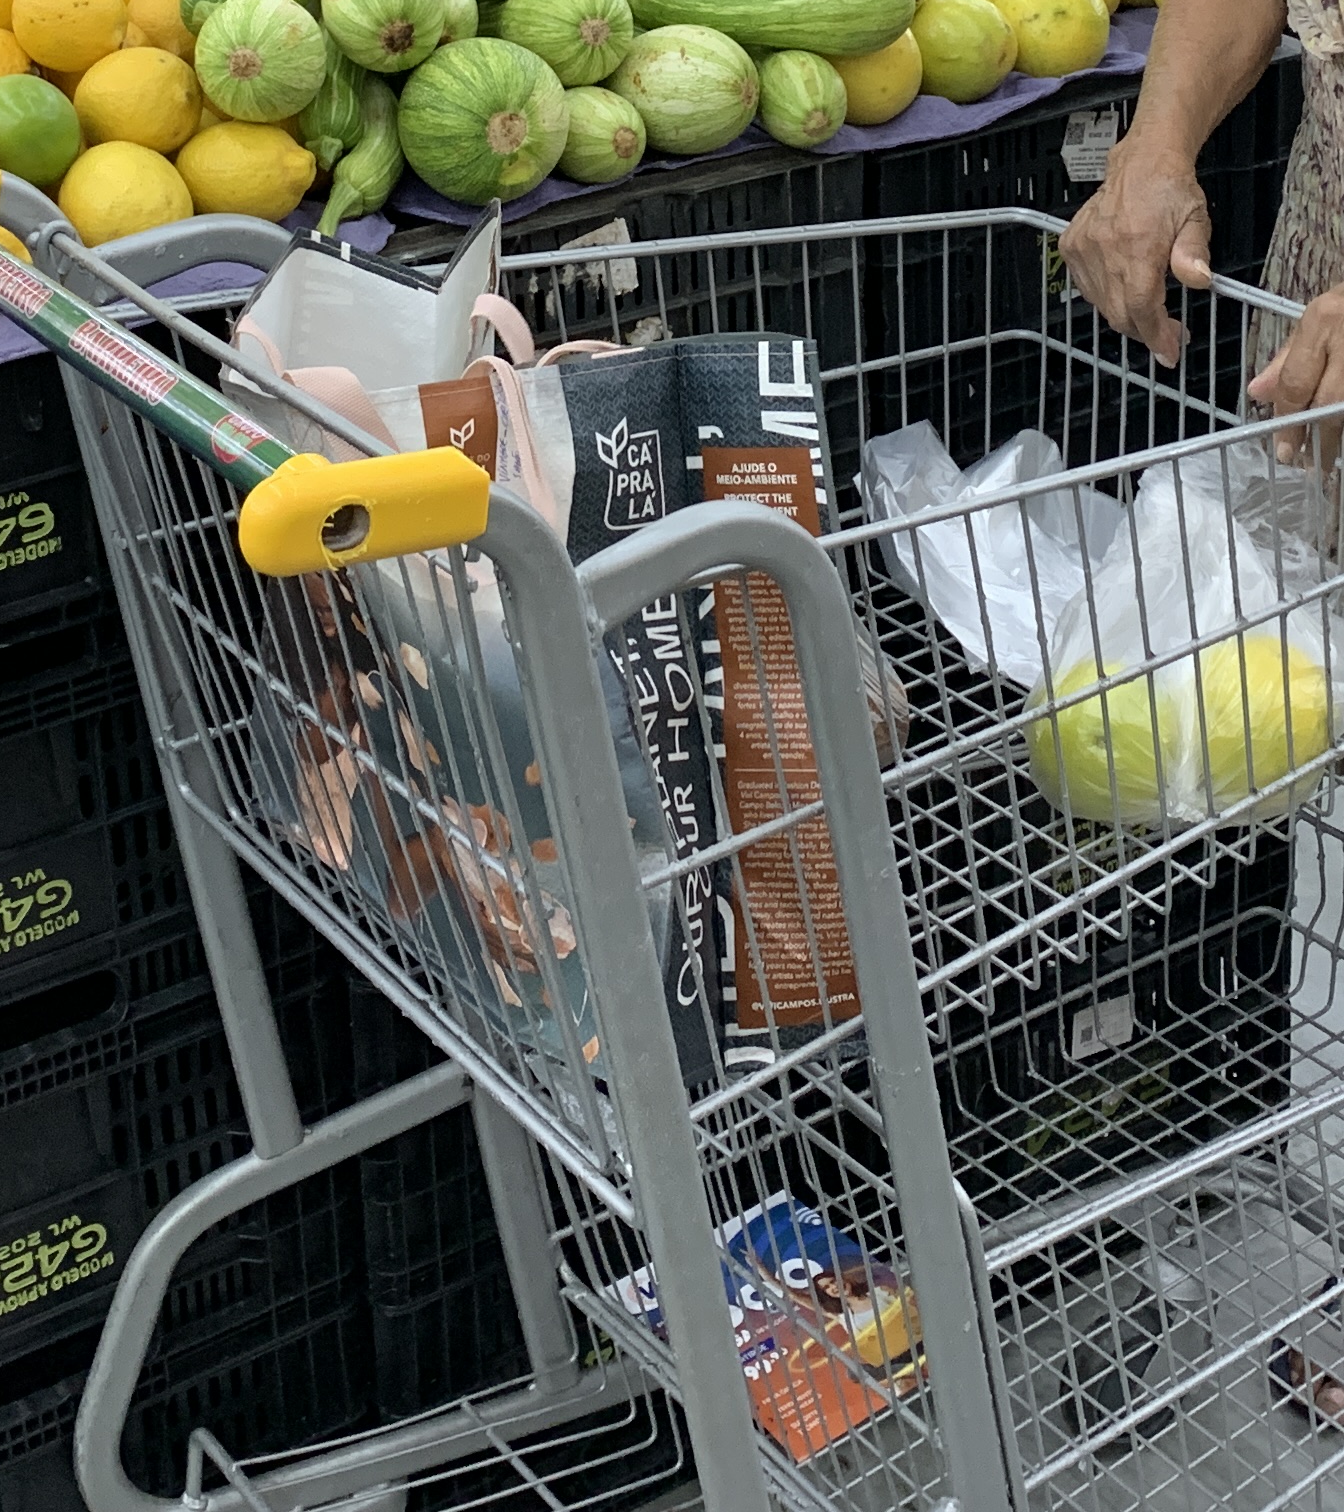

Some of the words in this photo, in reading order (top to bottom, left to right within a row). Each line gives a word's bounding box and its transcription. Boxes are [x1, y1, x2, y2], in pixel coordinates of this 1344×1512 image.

[731, 462, 767, 474] AJUDE
[766, 462, 778, 474] O
[616, 468, 655, 498] PRA
[715, 473, 798, 486] MEIO-AMBIENTE
[770, 492, 794, 504] THE
